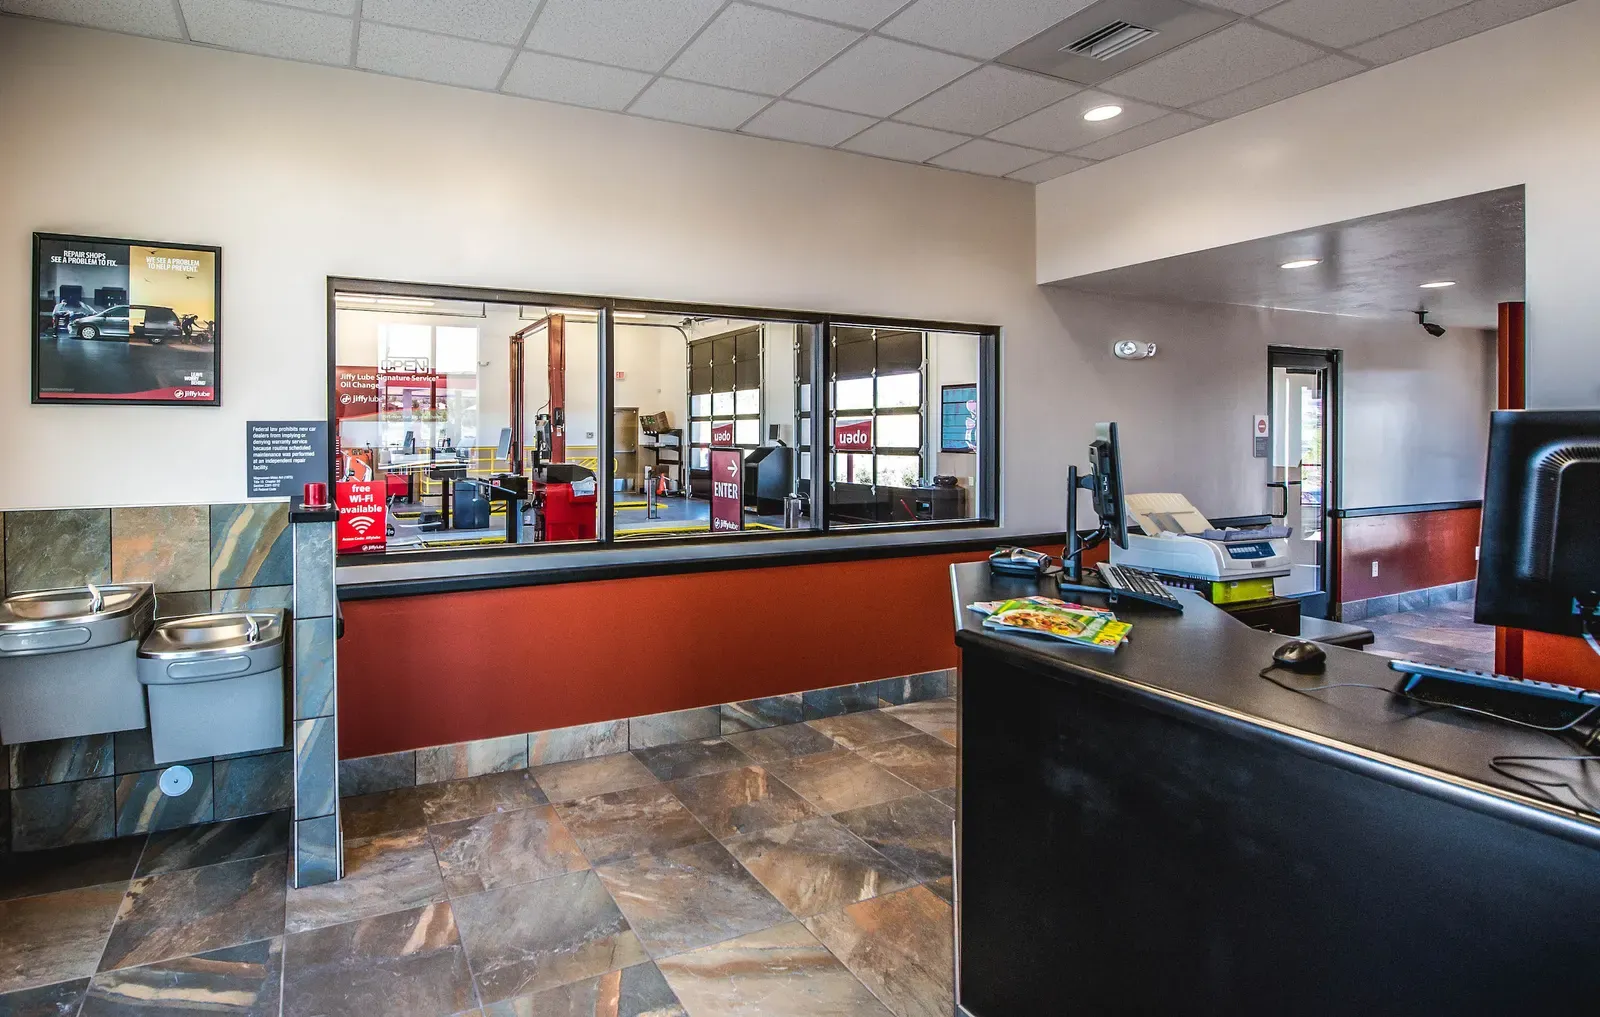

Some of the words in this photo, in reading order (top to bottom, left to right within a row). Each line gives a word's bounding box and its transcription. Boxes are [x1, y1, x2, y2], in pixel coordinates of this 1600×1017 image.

[63, 250, 85, 258] REPAIR
[85, 251, 106, 260] SHOPS
[50, 255, 62, 263] SEE
[62, 256, 67, 264] A
[68, 257, 97, 266] PROBLEM
[156, 256, 166, 264] SEE
[172, 258, 199, 266] PROBLEM
[148, 262, 155, 270] TO
[381, 359, 425, 372] OPEN
[340, 373, 356, 382] Jiffy
[376, 373, 411, 382] Signature
[352, 484, 370, 492] free
[714, 481, 738, 500] ENTER
[349, 494, 374, 503] Wi-Fi
[340, 504, 382, 514] available
